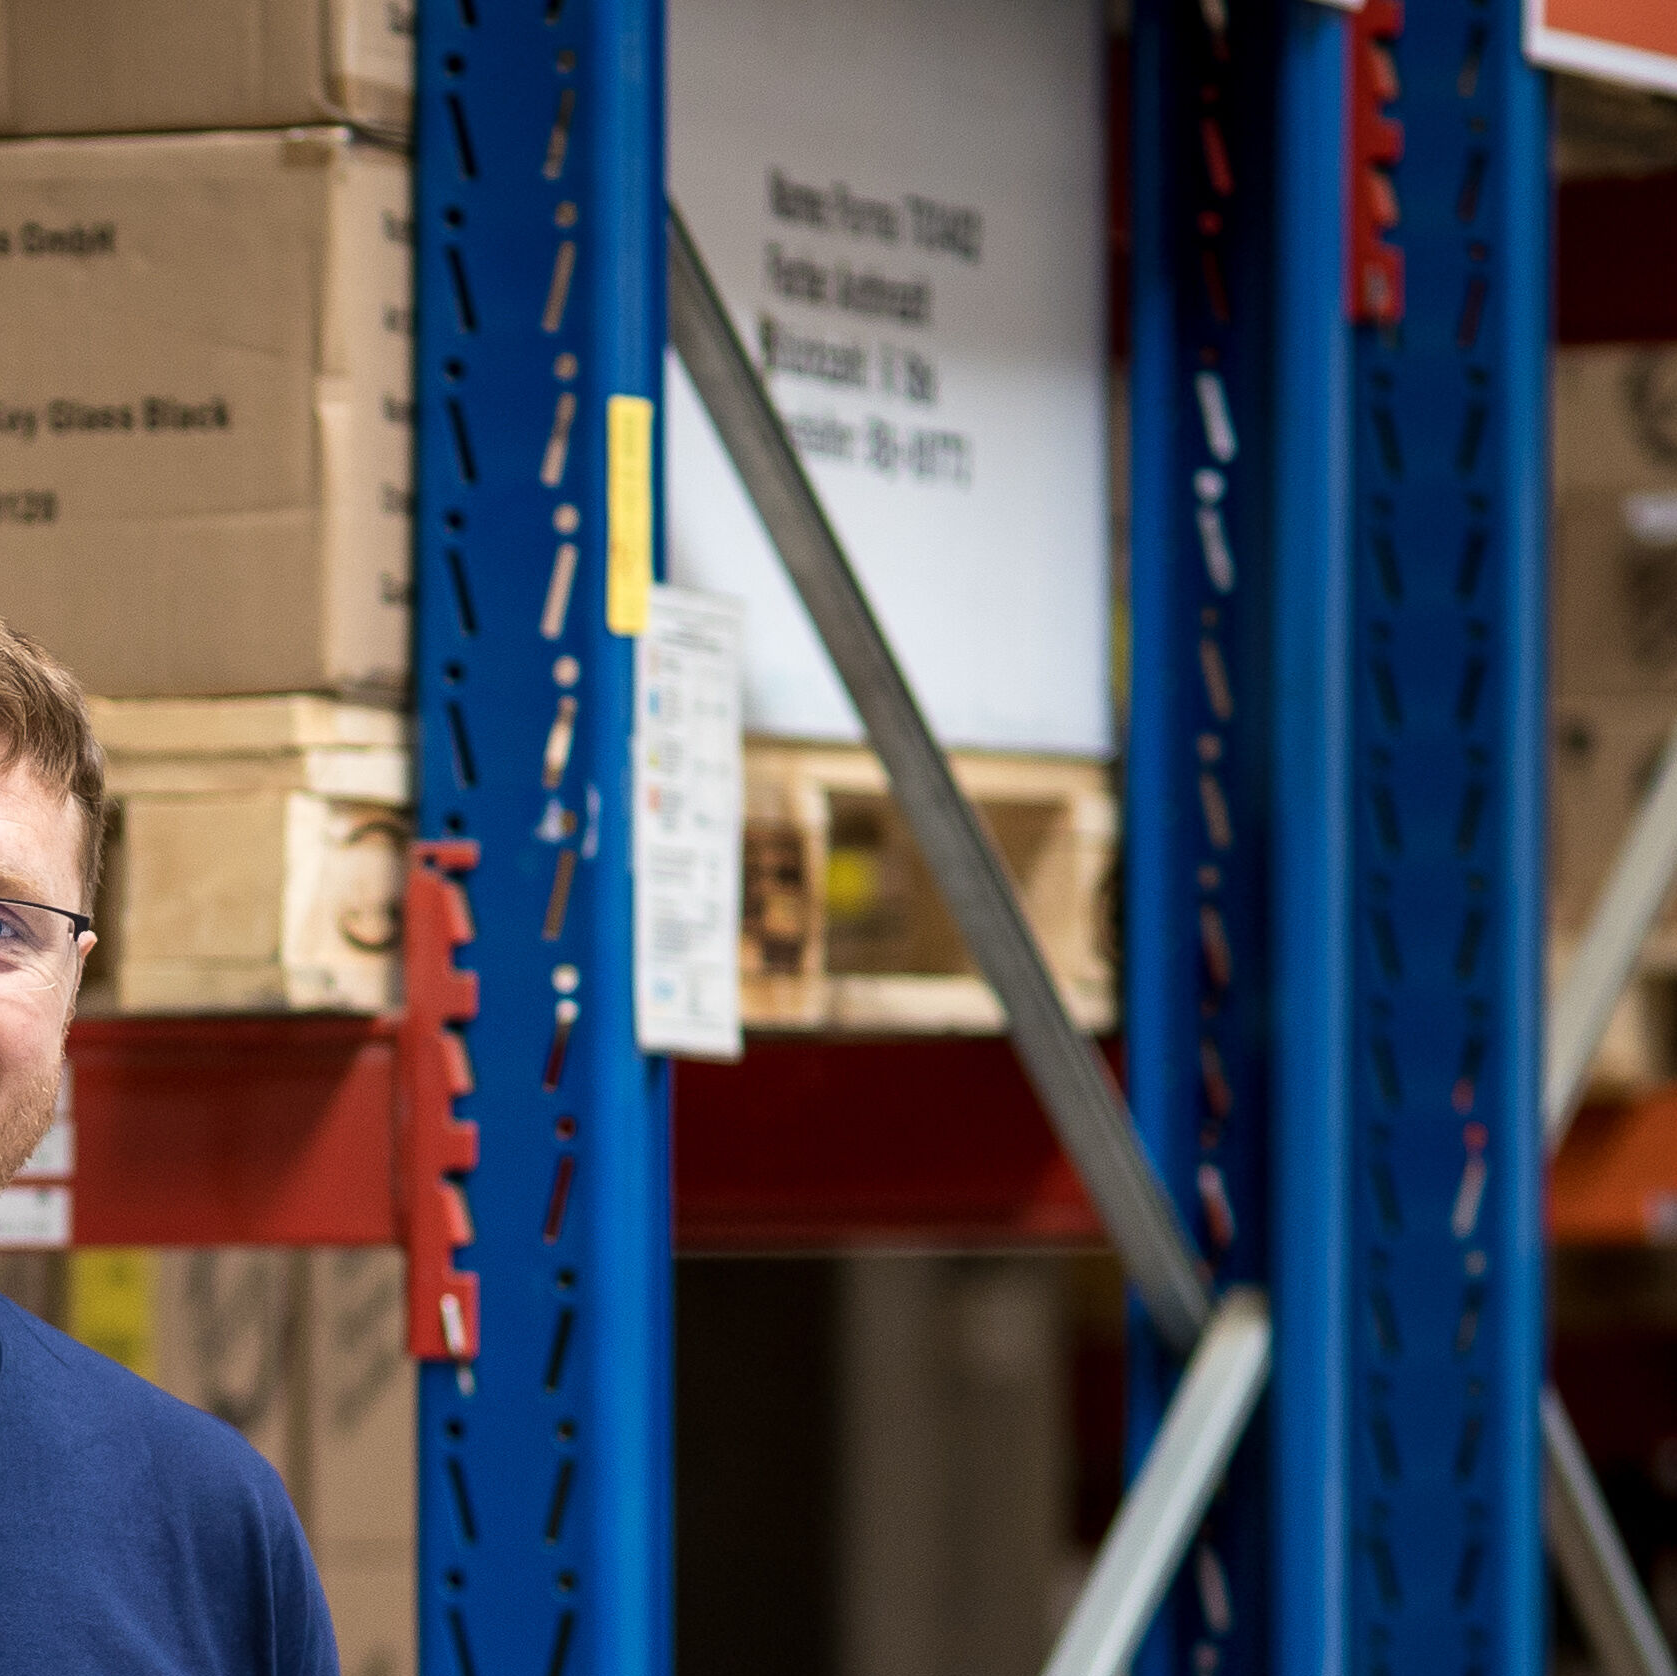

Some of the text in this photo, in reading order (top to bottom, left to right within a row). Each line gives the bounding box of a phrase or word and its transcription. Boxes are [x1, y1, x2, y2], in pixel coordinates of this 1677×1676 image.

[18, 219, 120, 261] GmbH
[45, 397, 137, 438] Glass
[141, 394, 234, 435] Black
